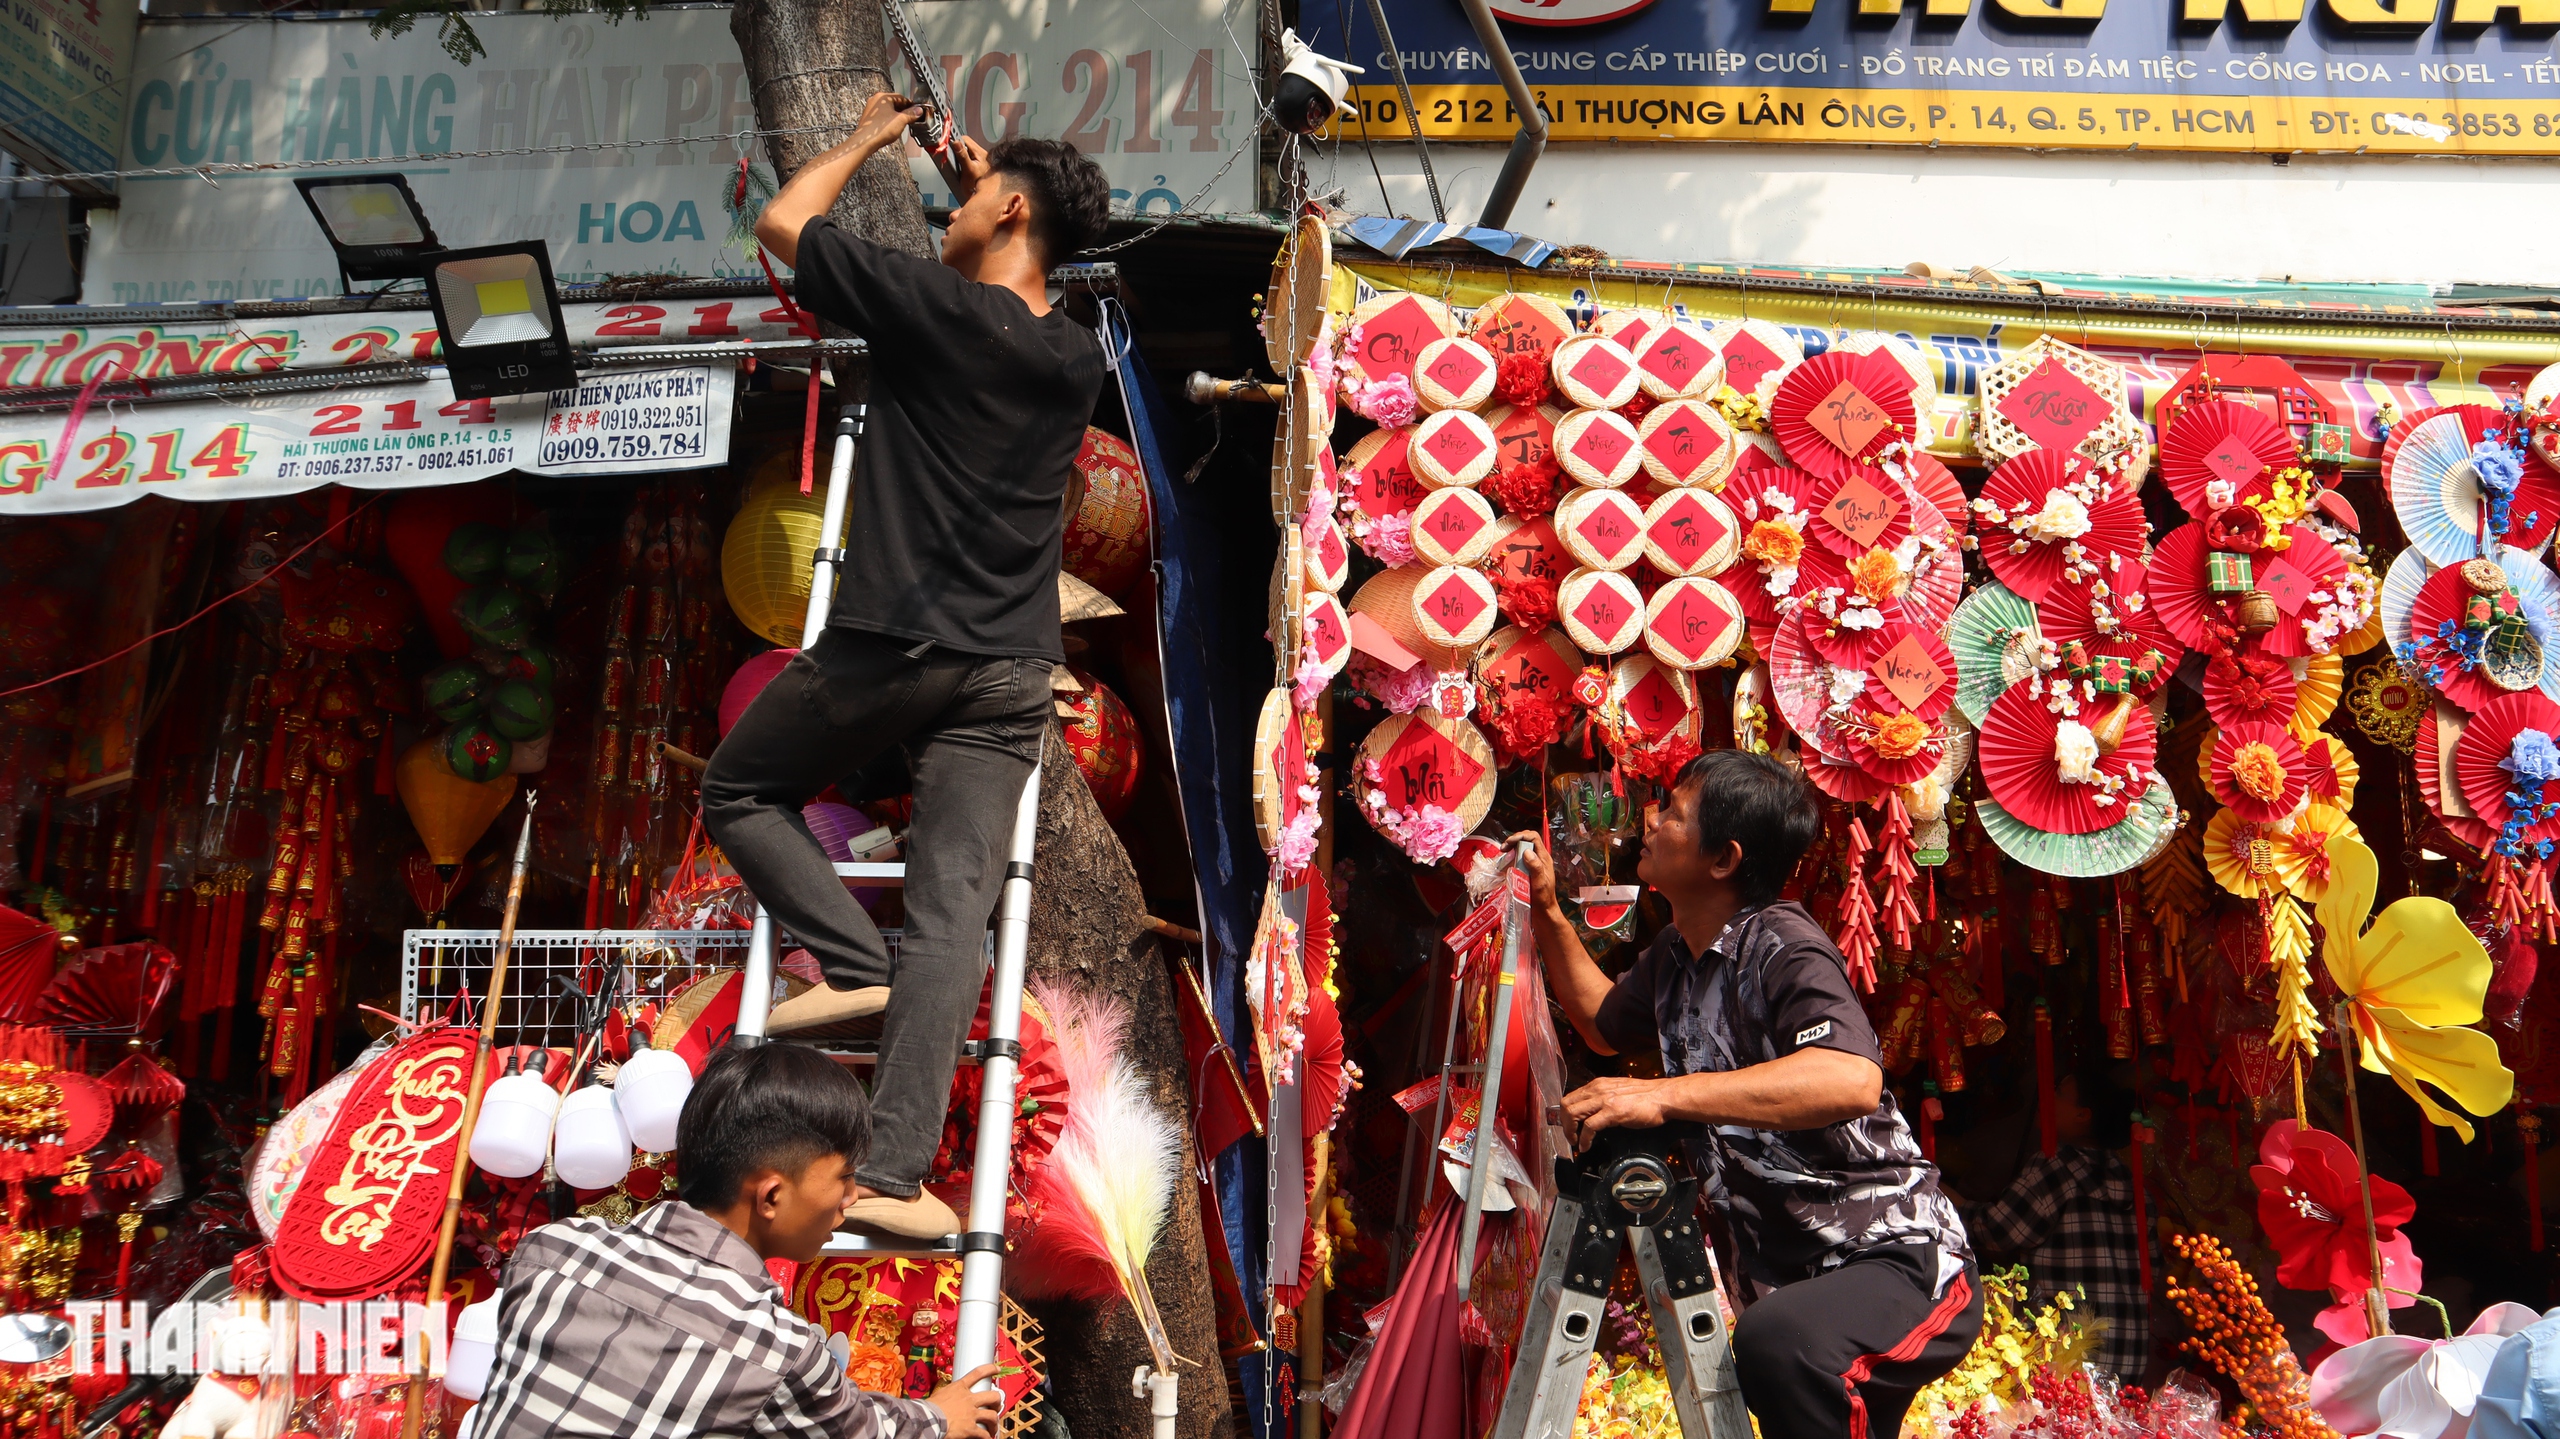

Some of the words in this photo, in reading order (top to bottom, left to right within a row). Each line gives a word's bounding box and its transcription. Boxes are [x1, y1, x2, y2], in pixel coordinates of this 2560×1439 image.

[51, 29, 90, 73] THẢM
[1376, 47, 1489, 71] CHUYÊN
[1511, 50, 1596, 71] CUNG
[1605, 43, 1667, 72] CẤP
[1673, 48, 1747, 76] THIỆP
[1755, 47, 1828, 74] CƯỚI
[1861, 47, 1906, 76] ĐỒ
[1913, 56, 2011, 78] TRANG
[2017, 52, 2055, 78] TRÍ
[2063, 52, 2130, 79] ĐÁM
[2139, 55, 2198, 83] TIỆC
[2225, 52, 2318, 82] CỔNG
[2325, 62, 2392, 83] HOA
[2419, 63, 2495, 84] NOEL
[2521, 55, 2560, 85] TẾT
[131, 46, 253, 167] CỬA
[280, 52, 457, 163] HÀNG
[468, 24, 641, 171] HẢI
[1060, 48, 1232, 155] 214
[1342, 99, 1398, 124] 210
[1434, 99, 1494, 124] 212
[1575, 99, 1726, 130] THƯỢNG
[1821, 98, 1916, 133] ÔNG,
[2027, 106, 2066, 131] Q.
[2115, 108, 2160, 132] TP.
[2173, 109, 2255, 133] HCM
[2310, 111, 2360, 135] ĐT:
[2442, 113, 2522, 137] 3853
[576, 199, 706, 245] HOA
[373, 248, 404, 258] 100W
[498, 364, 529, 380] LED
[550, 389, 578, 409] MAI
[579, 381, 613, 407] HIÊN
[2023, 389, 2090, 427] Xuân
[309, 397, 497, 437] 214
[601, 405, 703, 431] 0919.322.951
[75, 423, 256, 489] 214
[277, 462, 301, 478] ĐT:
[304, 455, 404, 477] 0906.237.537
[418, 446, 515, 470] 0902.451.061
[283, 440, 309, 458] HẢI
[313, 436, 369, 456] THƯỢNG
[407, 432, 435, 449] ÔNG
[440, 431, 472, 447] P.14
[488, 428, 513, 443] Q.5
[543, 431, 702, 463] 0909.759.784
